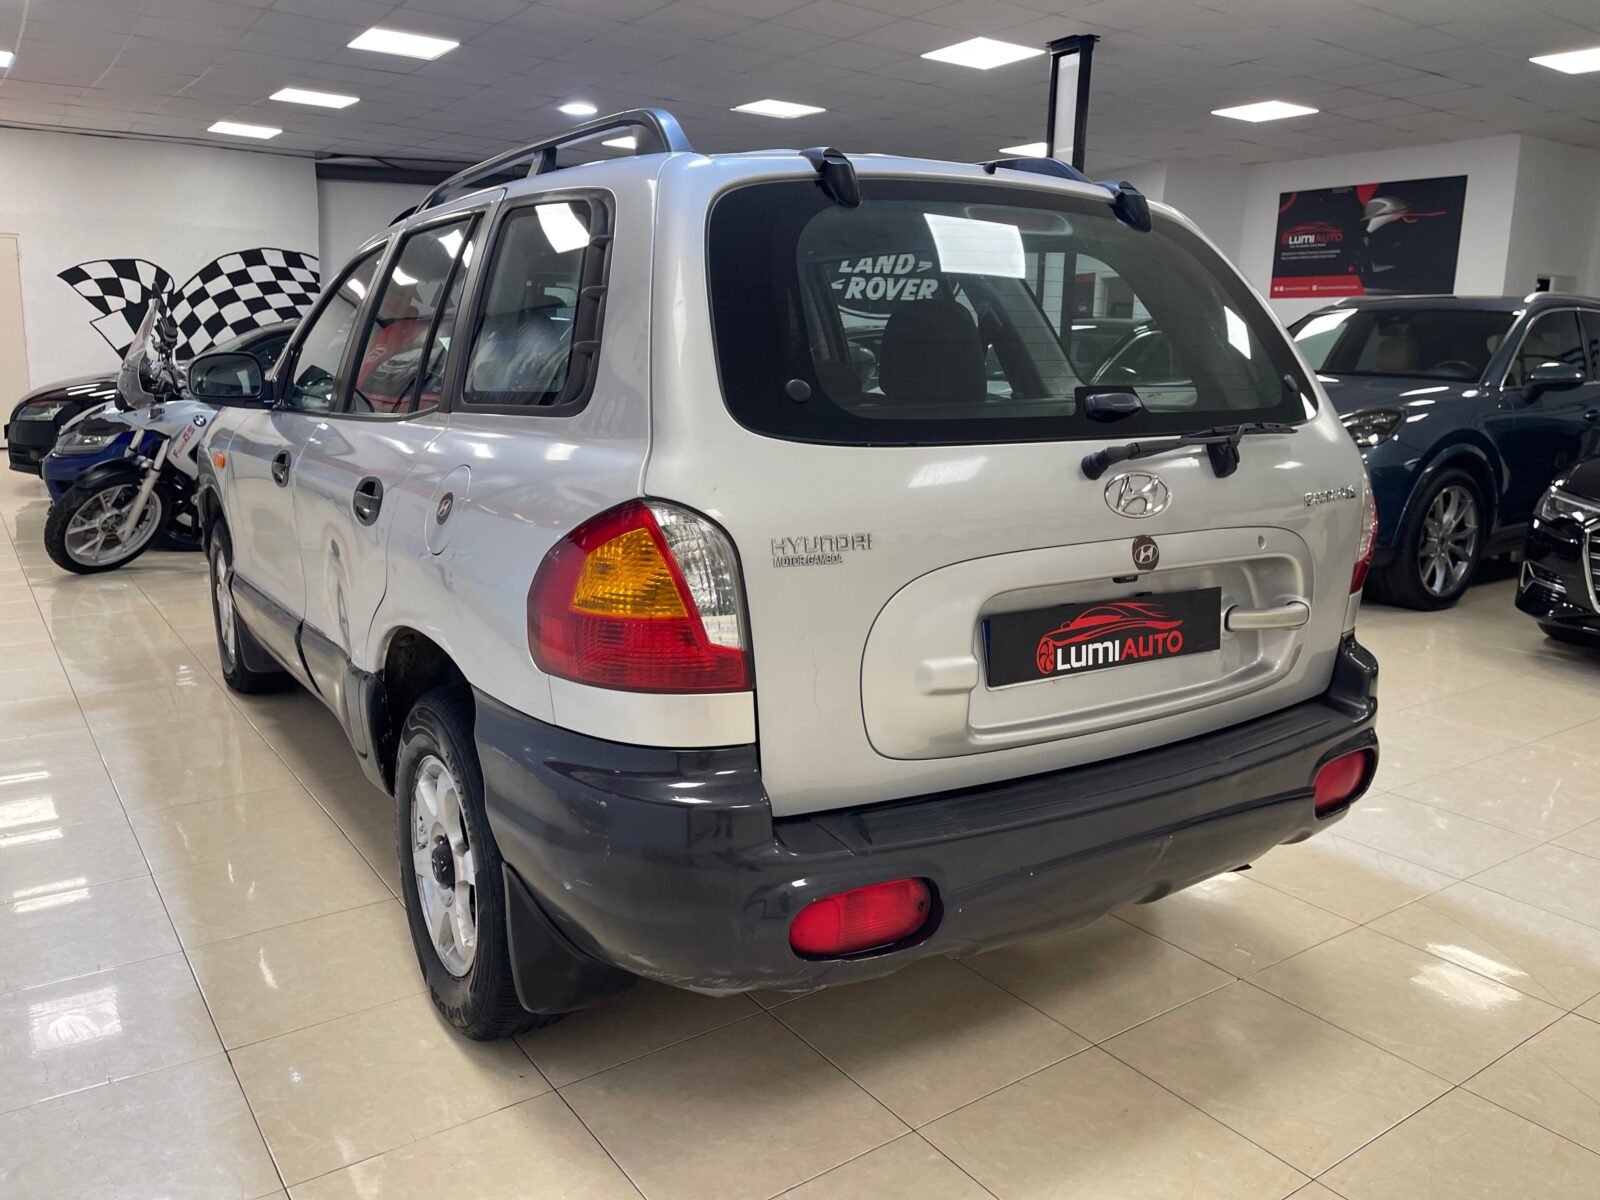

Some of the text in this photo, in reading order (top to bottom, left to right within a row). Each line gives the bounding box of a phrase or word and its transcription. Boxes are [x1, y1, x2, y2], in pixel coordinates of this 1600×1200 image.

[1289, 233, 1342, 244] LUMIAUTO
[839, 253, 915, 274] LAND
[844, 276, 939, 301] ROVER
[771, 533, 872, 555] HYUNDAI
[1056, 630, 1183, 670] LUMIAUTO
